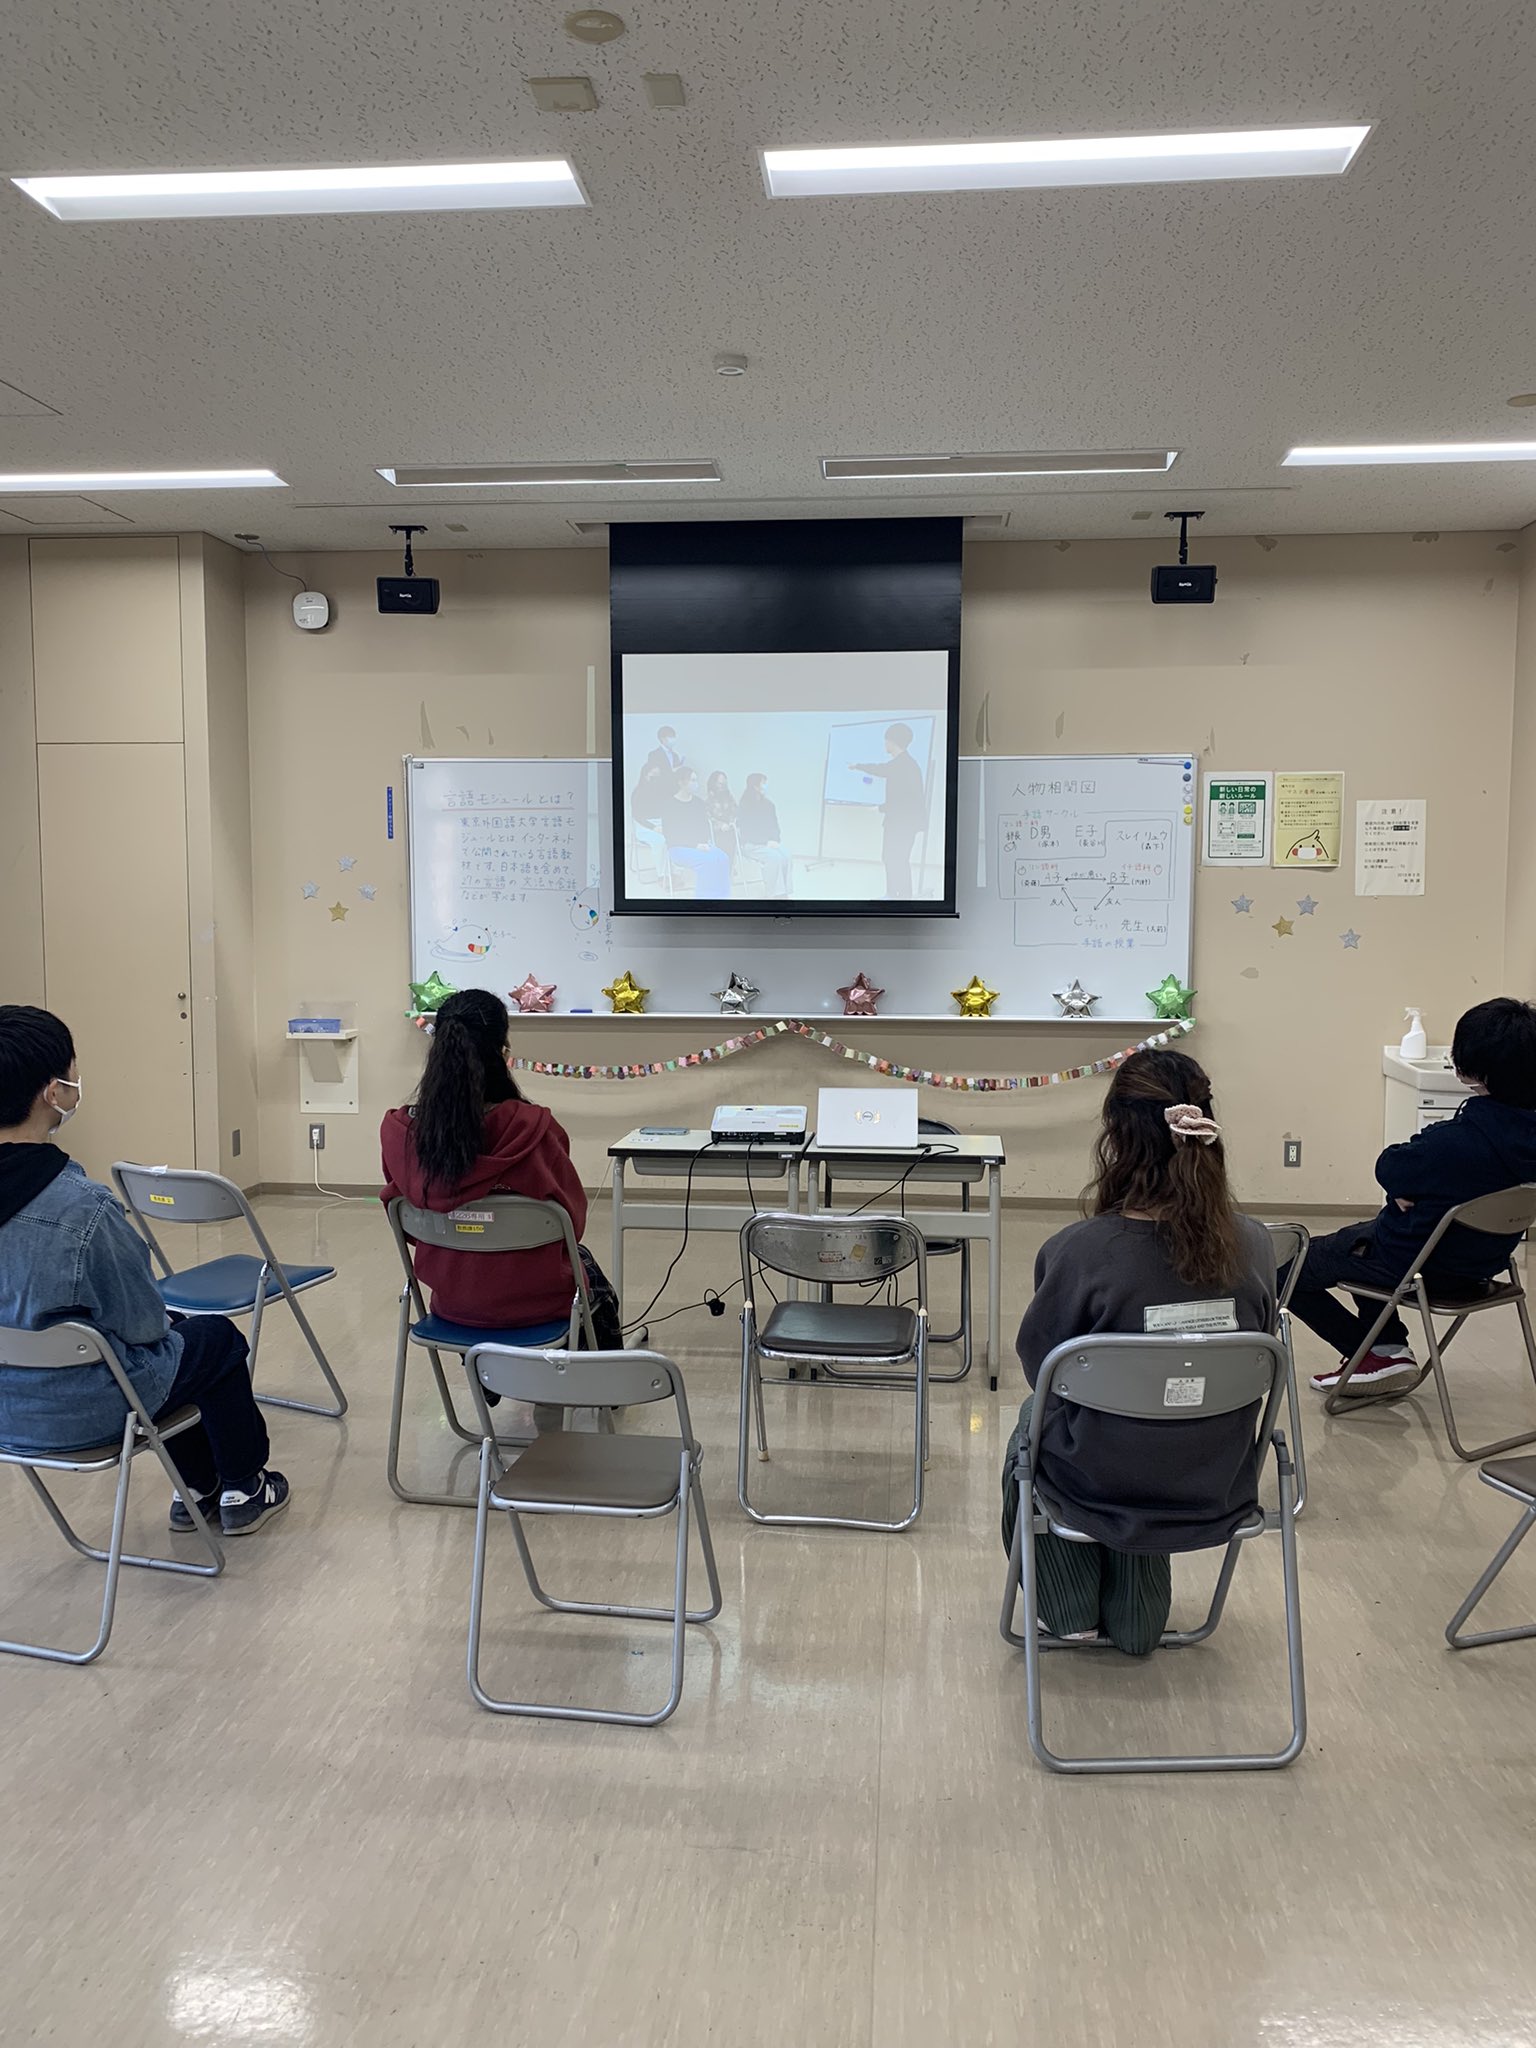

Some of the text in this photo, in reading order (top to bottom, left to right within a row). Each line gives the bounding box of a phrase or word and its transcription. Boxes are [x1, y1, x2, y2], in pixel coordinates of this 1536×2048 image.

[1011, 781, 1096, 797] 人物相関図
[1121, 919, 1144, 932] 先生
